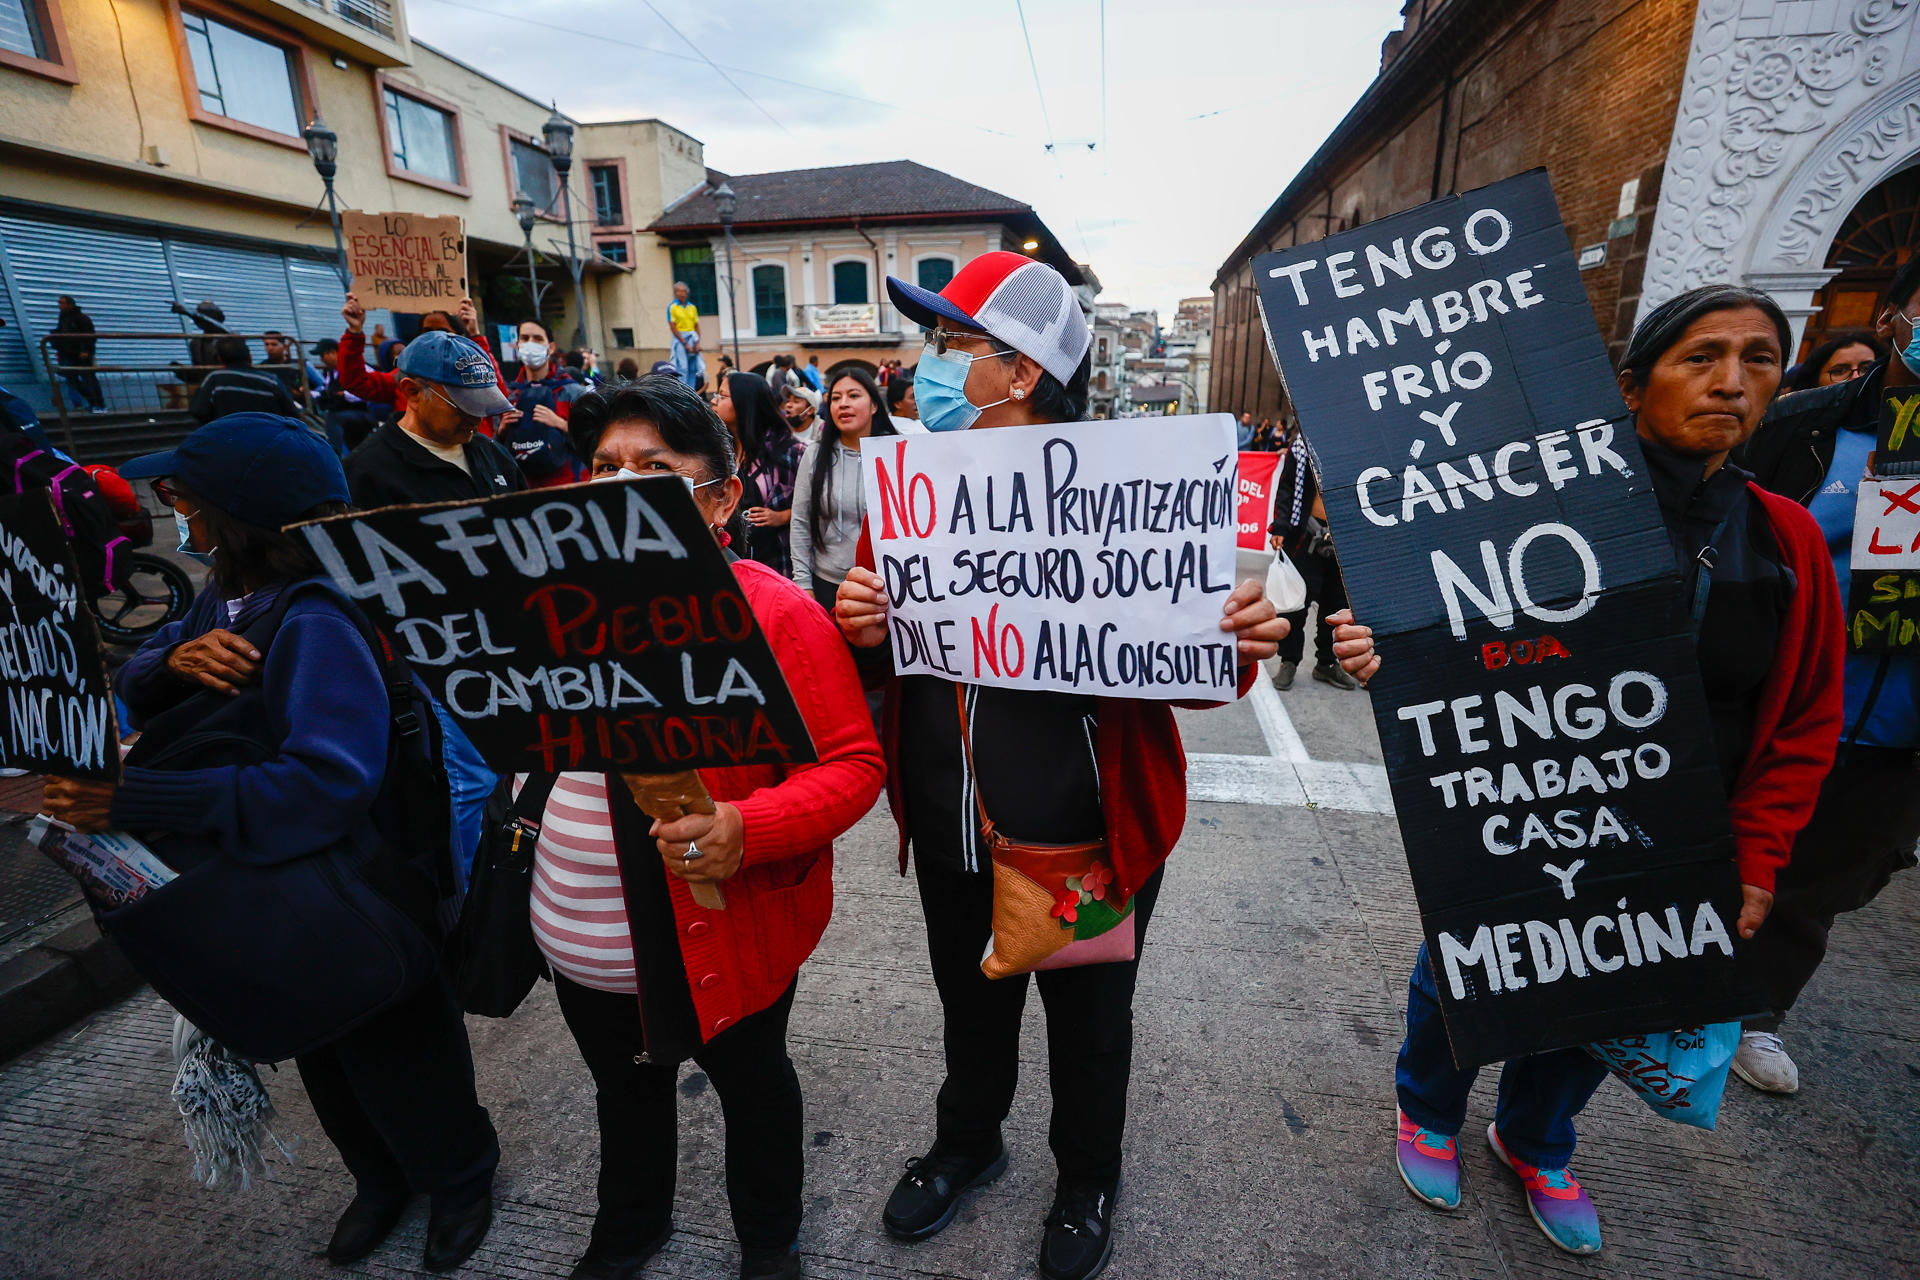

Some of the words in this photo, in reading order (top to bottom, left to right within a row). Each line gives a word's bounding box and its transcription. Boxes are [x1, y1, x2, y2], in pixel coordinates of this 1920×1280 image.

[384, 216, 408, 237] LO
[1269, 208, 1512, 306] TENGO
[353, 259, 428, 279] INVISIBLE
[436, 263, 450, 279] AL
[375, 278, 455, 298] PRESIDENTE
[1302, 268, 1546, 362] HAMBRE
[1362, 339, 1493, 411] FRÍO
[1419, 401, 1462, 446] Y
[875, 439, 937, 540] NO
[949, 474, 976, 535] A
[987, 471, 1034, 533] LA
[1042, 437, 1238, 547] PRIVATIZACIÓN
[1239, 479, 1265, 498] DEL
[1356, 418, 1634, 527] CÁNCER
[301, 519, 447, 617] LA
[419, 485, 688, 578] FURIA
[882, 554, 946, 609] DEL
[949, 549, 1085, 604] SEGURO
[1093, 541, 1231, 604] SOCIAL
[1430, 522, 1602, 640] NO
[395, 608, 516, 666] DEL
[524, 583, 752, 657] PUEBLO
[893, 616, 962, 676] DILE
[971, 602, 1024, 679] NO
[1482, 635, 1571, 670] BOA
[445, 659, 664, 719] CAMBIA
[681, 651, 766, 706] LA
[1397, 671, 1668, 757] TENGO
[526, 708, 793, 773] HISTORIA
[1430, 743, 1670, 808] TRABAJO
[1482, 806, 1630, 855] CASA
[1543, 859, 1586, 899] Y
